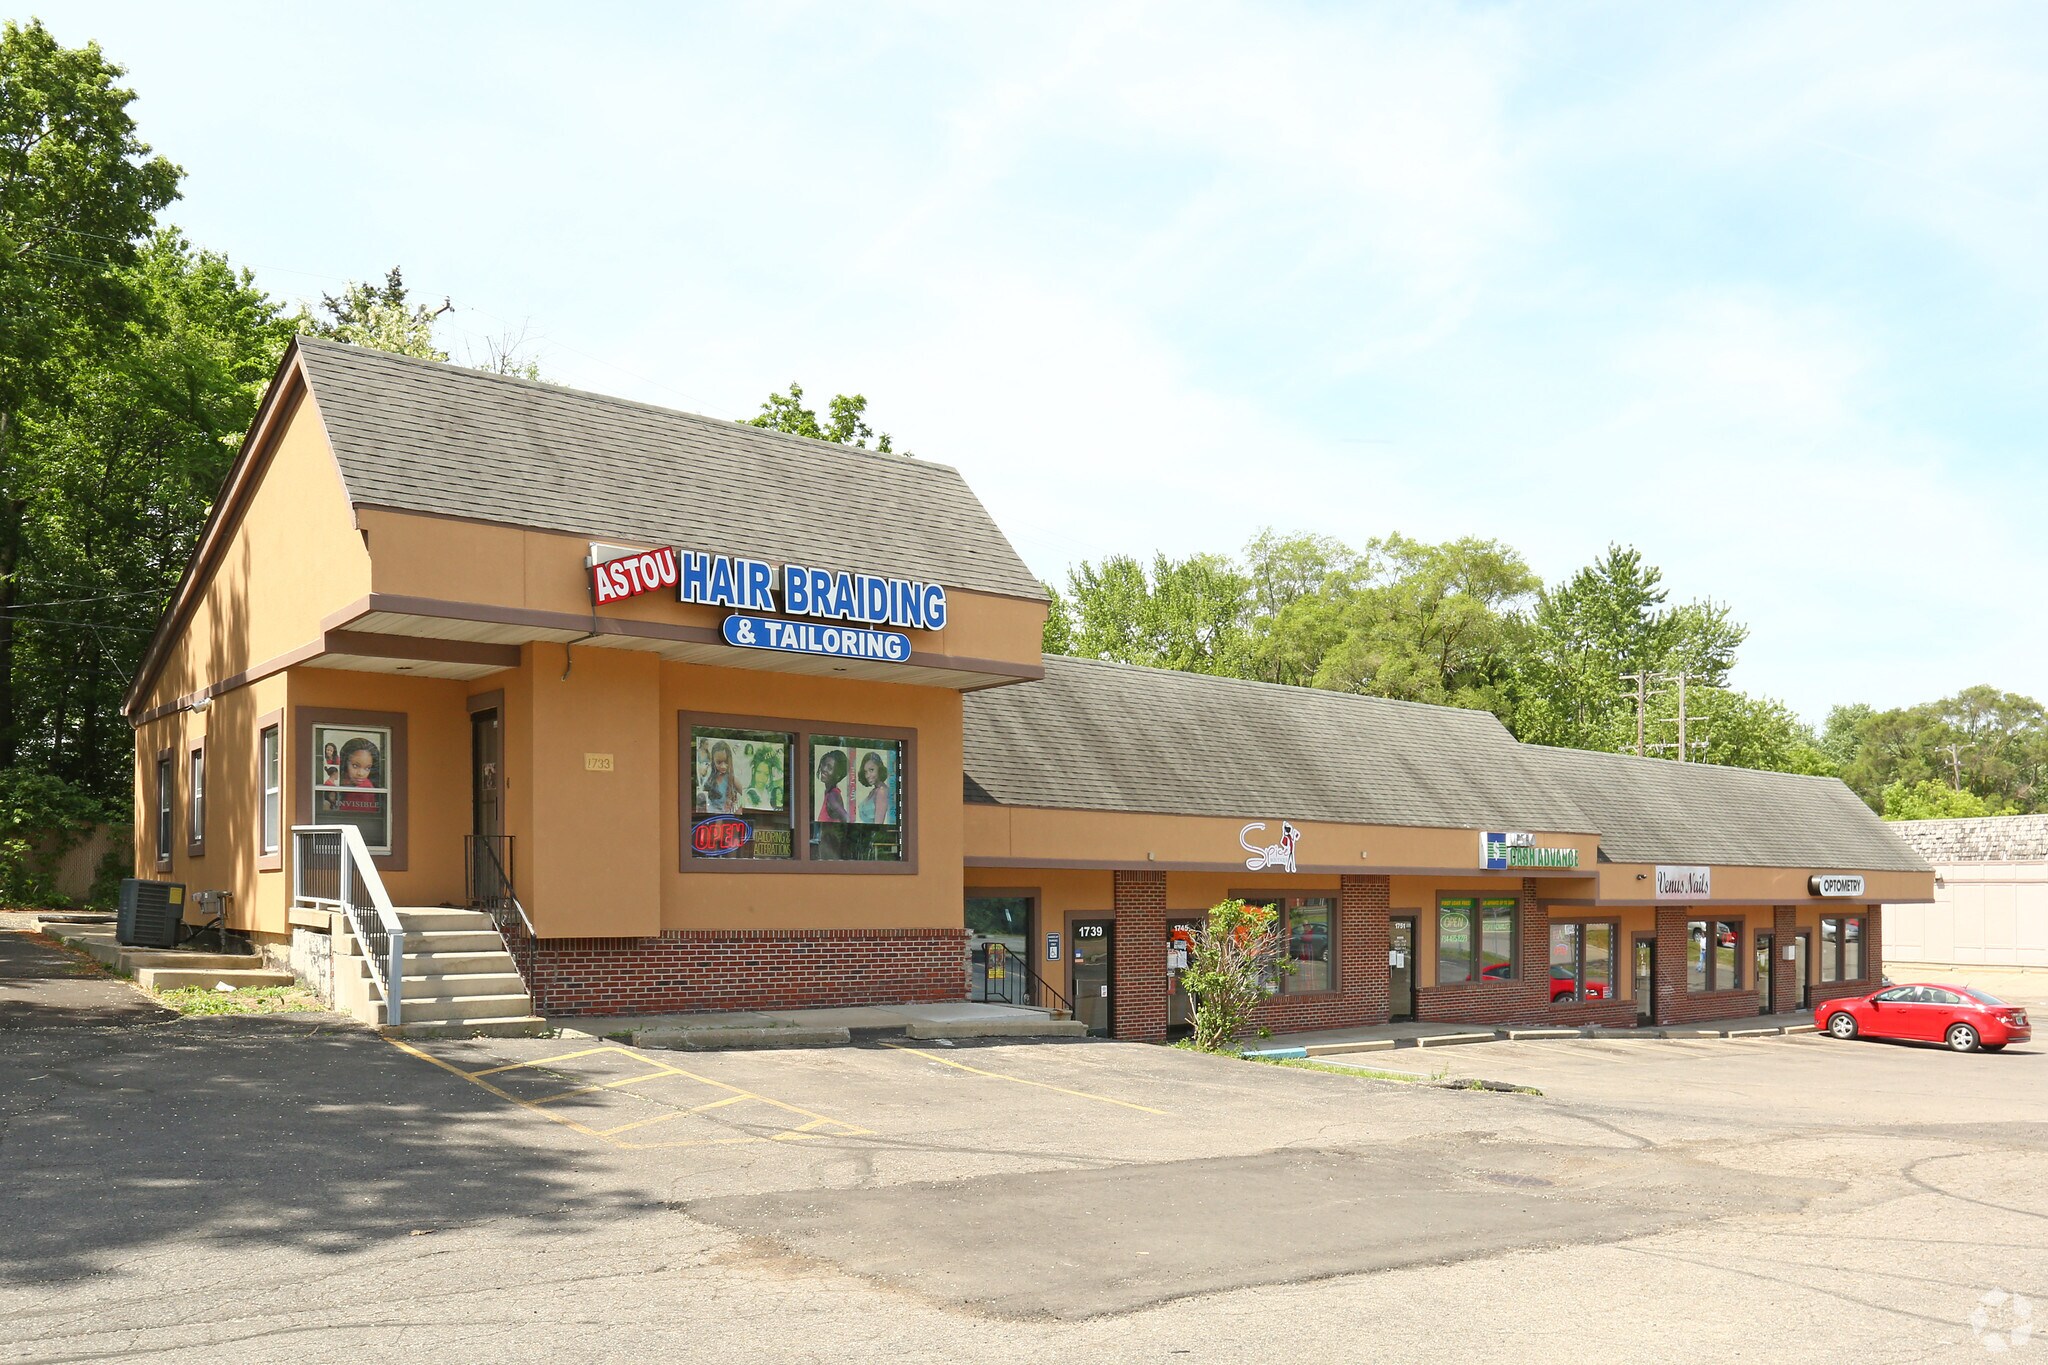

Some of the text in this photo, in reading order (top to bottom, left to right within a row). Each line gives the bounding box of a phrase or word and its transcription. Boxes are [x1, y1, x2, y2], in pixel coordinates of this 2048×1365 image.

[594, 548, 947, 632] ASTOU HAIR BRAIDING
[736, 619, 902, 660] & TAILORING
[587, 758, 610, 769] 1733
[336, 800, 380, 808] INVISIBLE
[695, 822, 746, 850] OPEN
[1510, 847, 1578, 867] CASH ADVANCE
[1658, 871, 1708, 894] Venus Nails
[1823, 879, 1861, 892] OPTOMETRY
[1443, 916, 1464, 928] OPEN
[1079, 926, 1103, 937] 1739
